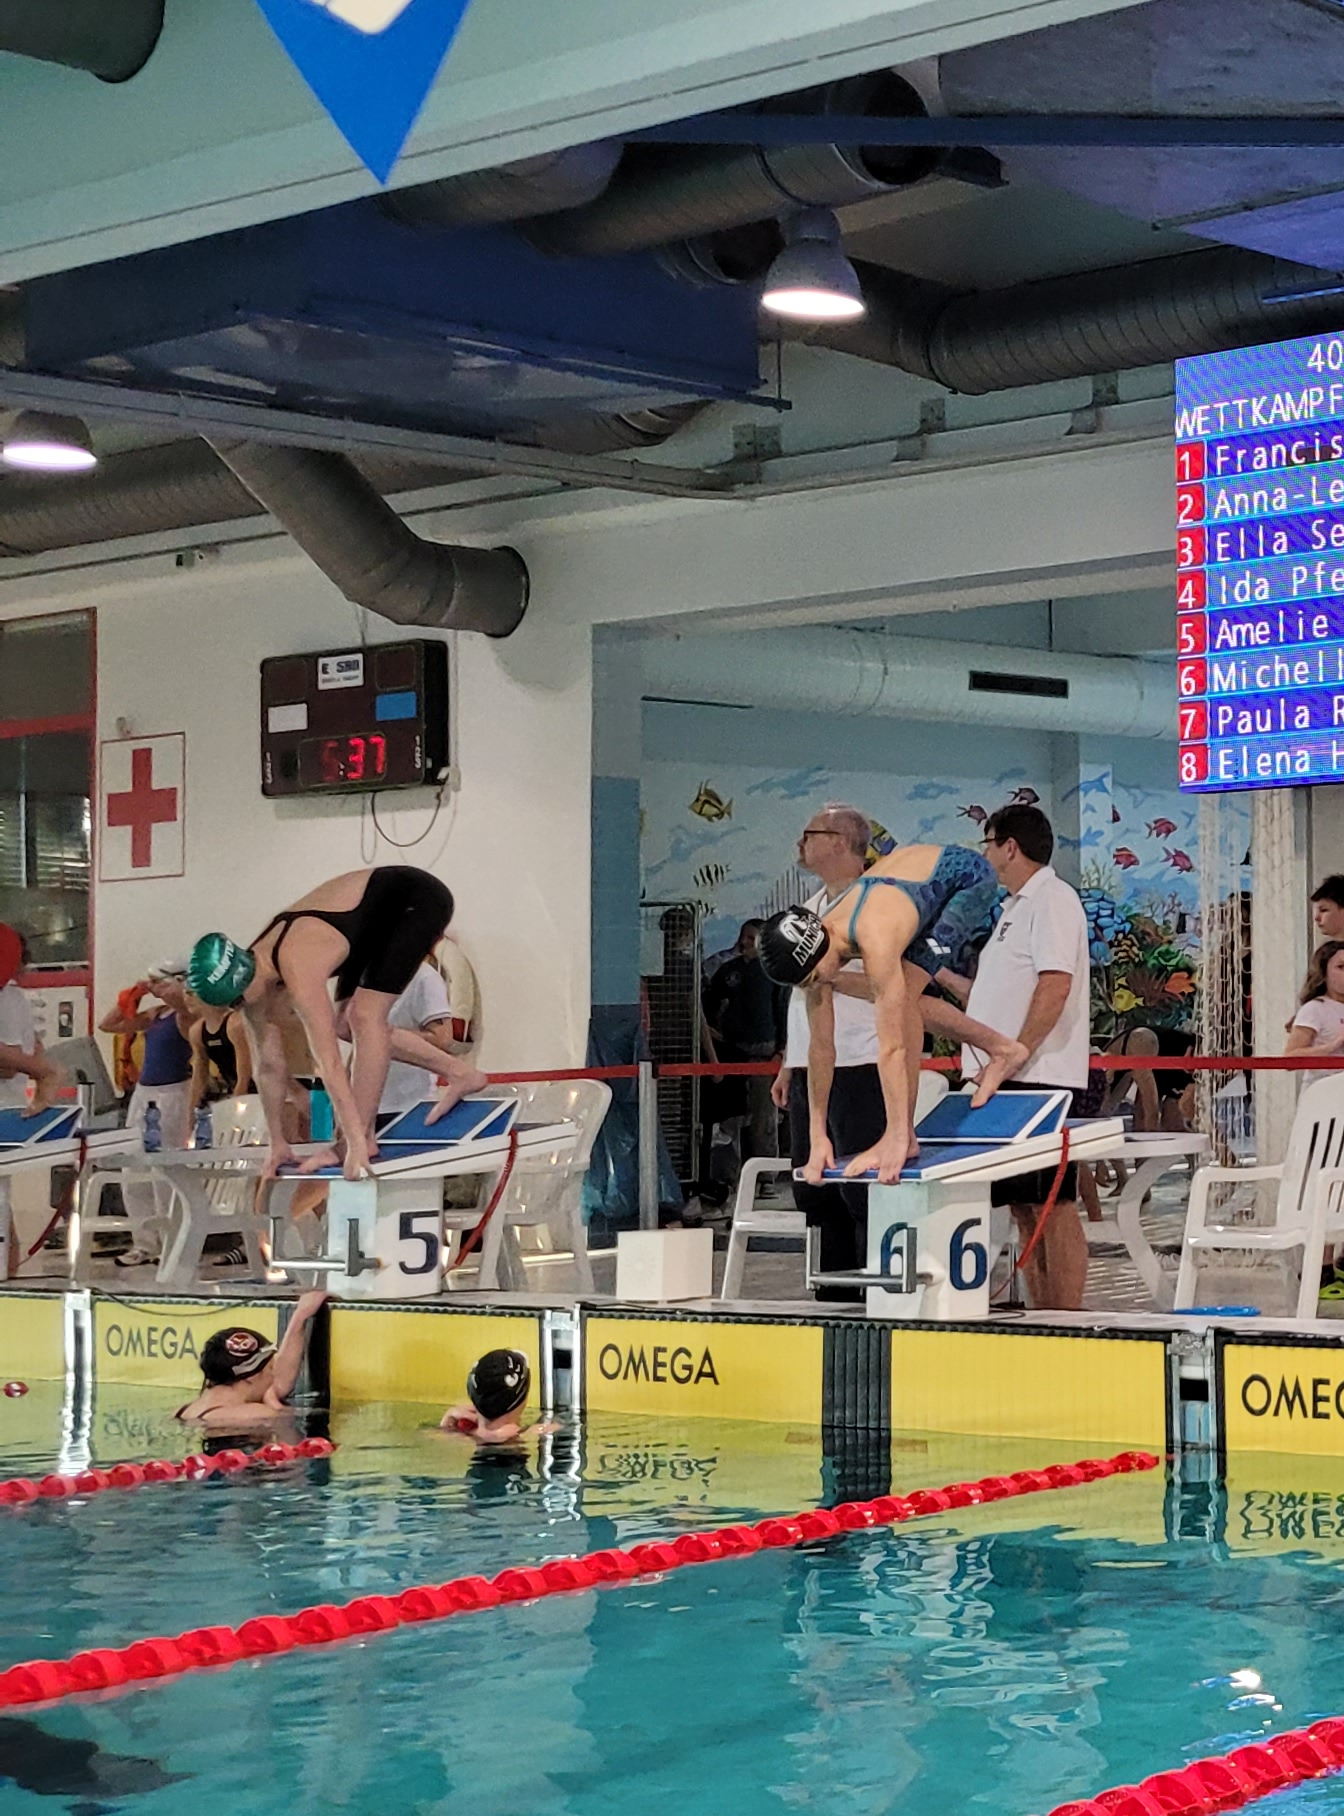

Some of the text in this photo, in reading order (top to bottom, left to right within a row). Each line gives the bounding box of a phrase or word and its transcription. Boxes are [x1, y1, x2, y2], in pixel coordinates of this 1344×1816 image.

[1174, 384, 1344, 438] WETTKAMPF
[1178, 451, 1191, 481] 1
[1178, 494, 1194, 523] 2
[1179, 536, 1193, 567] 3
[1217, 525, 1289, 561] Ella
[1177, 580, 1196, 609] 4
[1221, 571, 1270, 605] Ida
[1179, 628, 1195, 653] 5
[1215, 610, 1329, 649] Amelie
[1180, 668, 1196, 696] 6
[1179, 712, 1196, 740] 7
[1217, 703, 1310, 734] Paula
[1180, 752, 1196, 782] 8
[1217, 745, 1310, 779] Elena
[398, 1209, 440, 1275] 5
[949, 1217, 988, 1291] 6
[106, 1323, 199, 1361] OMEGA
[598, 1343, 721, 1386] OMEGA
